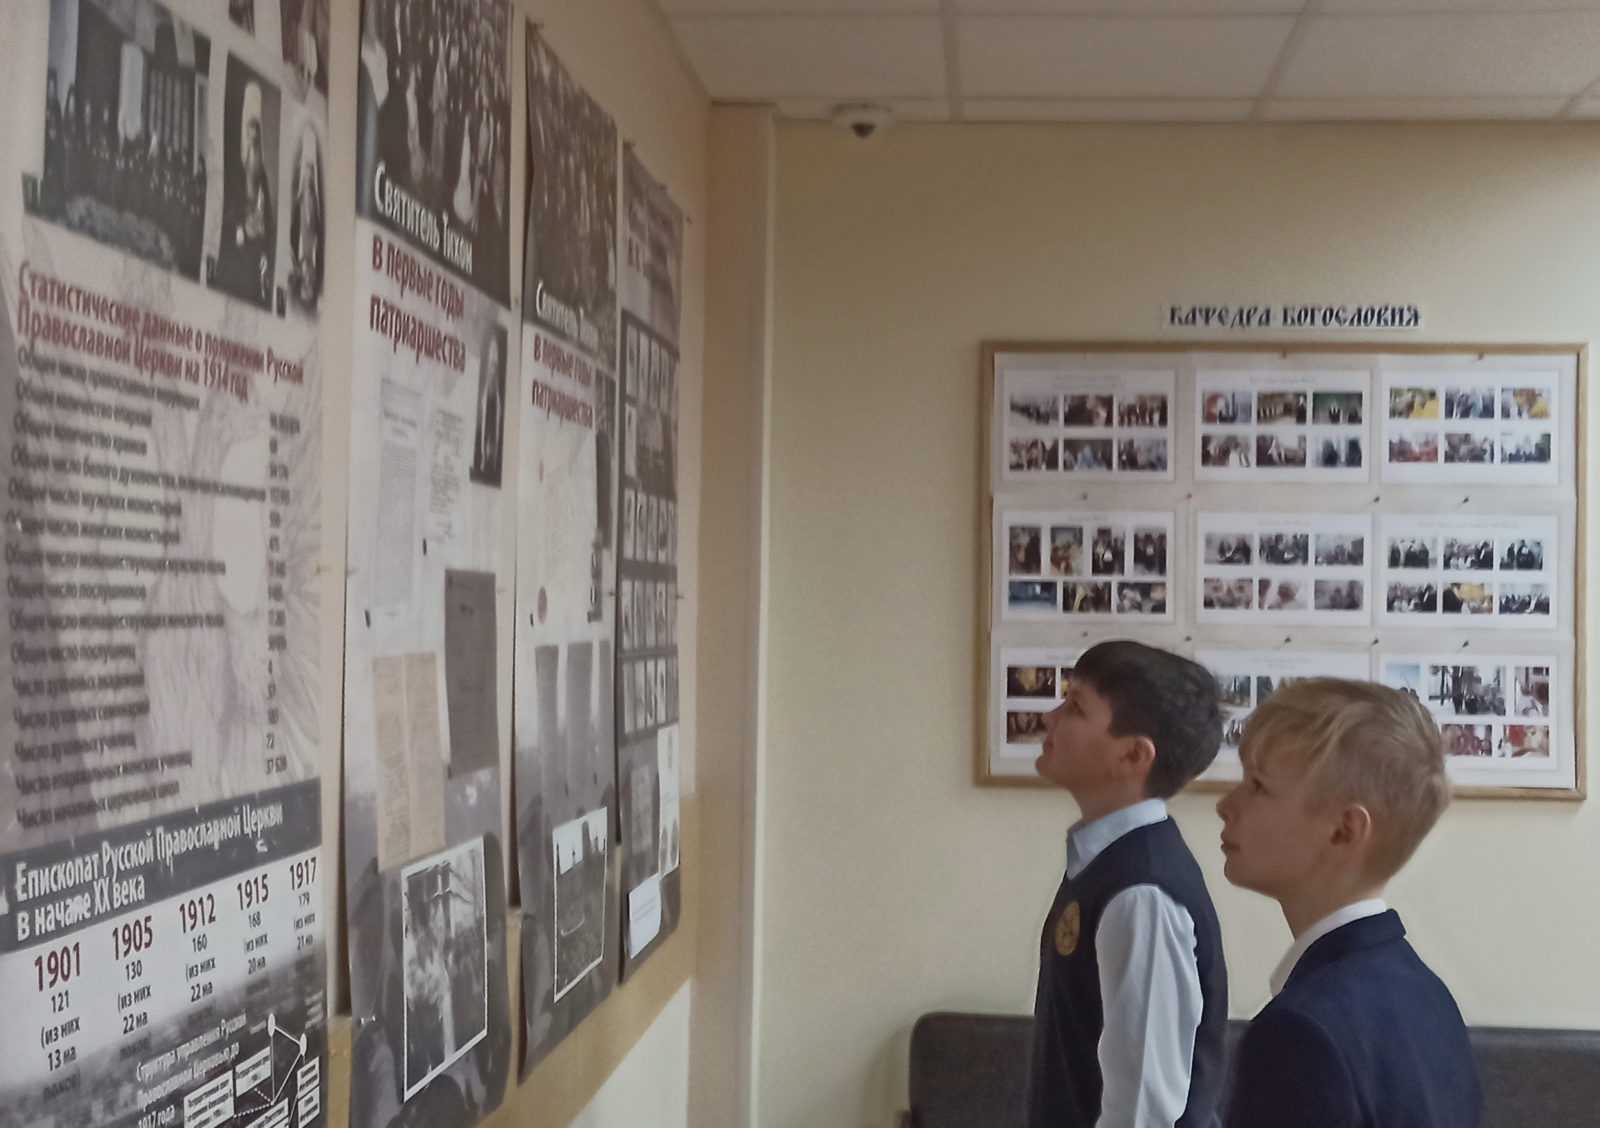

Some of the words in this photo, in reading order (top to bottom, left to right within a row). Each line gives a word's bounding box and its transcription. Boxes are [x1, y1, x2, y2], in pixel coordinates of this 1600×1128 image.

[386, 240, 433, 301] первые
[369, 293, 466, 375] патриаршества
[184, 357, 200, 384] на
[15, 853, 99, 902] Епископат
[102, 832, 154, 882] Русской
[156, 807, 241, 865] Православной
[242, 802, 283, 838] Церкви
[289, 856, 317, 891] 1917
[34, 892, 91, 936] начале
[112, 875, 145, 909] века
[236, 873, 269, 911] 1915
[179, 893, 216, 934] 1912
[112, 915, 153, 961] 1905
[192, 933, 208, 952] 160
[34, 941, 81, 992] 1901
[125, 959, 143, 981] 130
[51, 990, 69, 1013] 121
[117, 992, 132, 1013] (из
[133, 984, 151, 1005] них
[190, 983, 201, 1002] 22
[202, 982, 213, 996] на
[41, 1025, 59, 1048] (из
[60, 1016, 80, 1038] них
[123, 1013, 135, 1035] 22
[135, 1011, 148, 1029] на
[47, 1049, 62, 1072] 13
